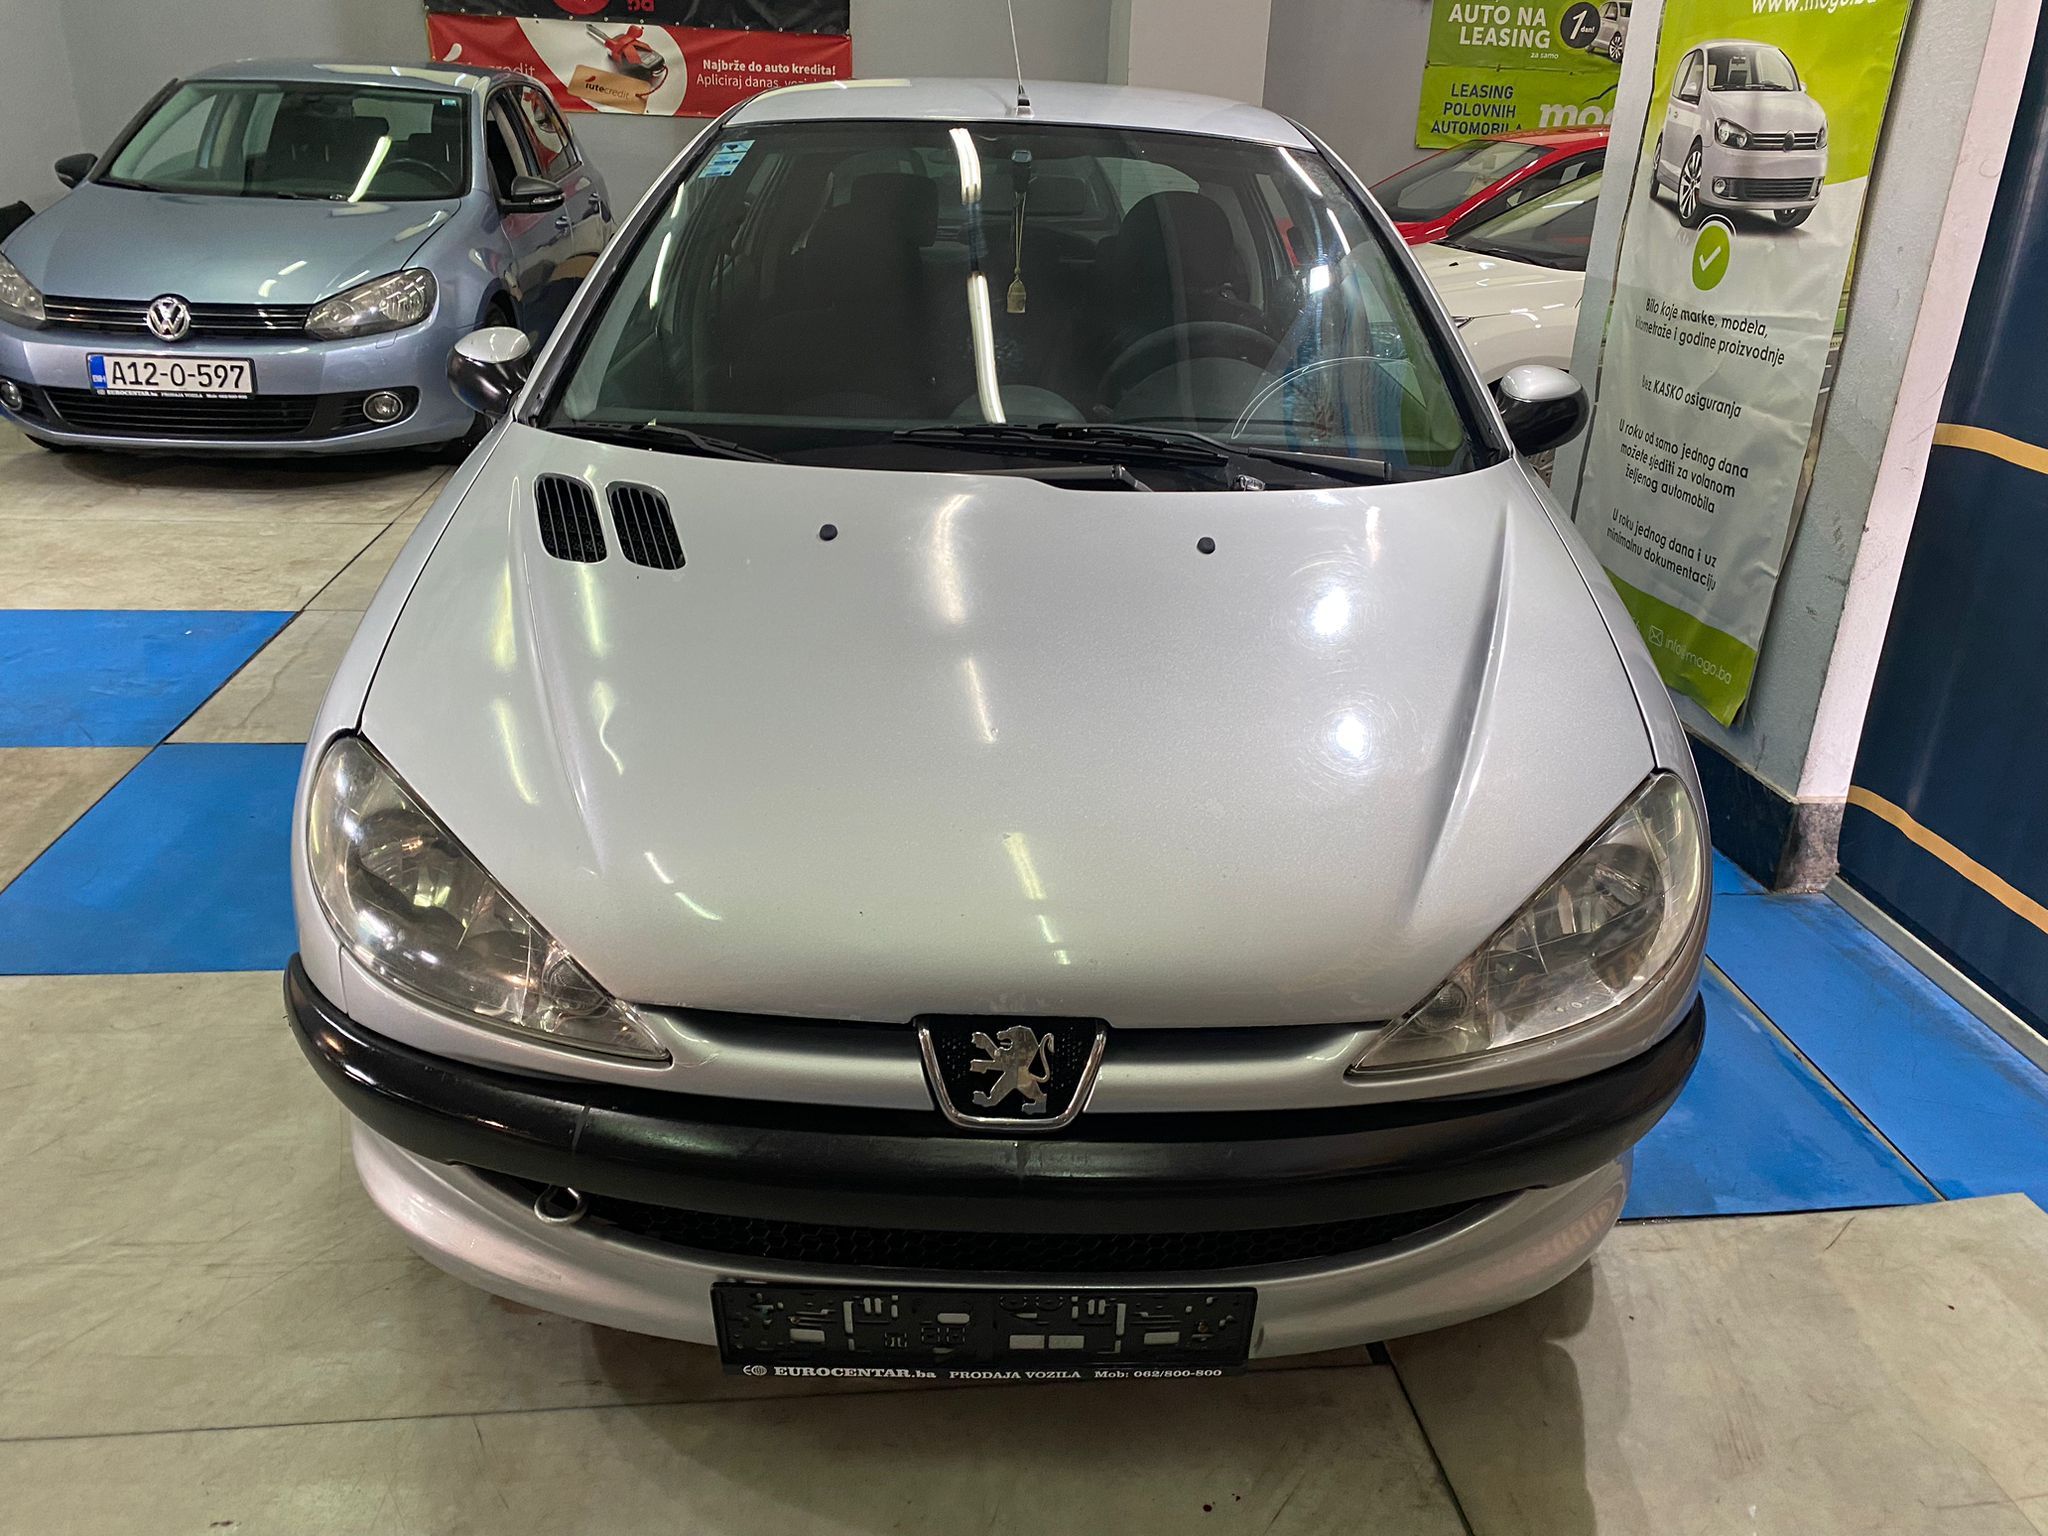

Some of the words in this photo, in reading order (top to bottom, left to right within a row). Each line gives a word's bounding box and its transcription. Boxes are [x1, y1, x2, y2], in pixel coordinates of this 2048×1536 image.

[1448, 3, 1511, 25] AUTO
[1517, 7, 1547, 27] NA
[1752, 0, 1876, 13] www.mog.
[1570, 10, 1588, 40] 1
[1459, 26, 1550, 49] LEASING
[702, 59, 746, 72] Najbrže
[748, 61, 762, 72] do
[764, 63, 790, 74] auto
[792, 63, 836, 76] kredita!
[1540, 52, 1559, 60] samo
[696, 74, 742, 90] Apliciraj
[1451, 83, 1514, 99] LEASING
[1443, 102, 1517, 118] POLOVNIH
[1538, 104, 1614, 128] mo
[1645, 297, 1659, 314] Bilo
[1660, 301, 1678, 321] koje
[1680, 309, 1718, 329] marke,
[1721, 316, 1768, 339] modela,
[1673, 326, 1678, 341] i
[1678, 331, 1717, 350] godine
[1717, 340, 1785, 367] proizvodnje
[1652, 379, 1684, 401] KASKO
[1684, 391, 1742, 419] osiguranja
[1618, 418, 1625, 432] U
[1624, 423, 1644, 440] roku
[1644, 431, 1655, 445] od
[1655, 436, 1679, 455] samo
[1680, 442, 1716, 471] jednog
[1718, 458, 1749, 479] dana
[1620, 442, 1648, 464] možete
[1648, 454, 1676, 475] sjediti
[1676, 466, 1688, 480] za
[1691, 471, 1736, 498] volanom
[1625, 463, 1659, 493] željenog
[1661, 482, 1715, 514] automobila
[1612, 507, 1619, 521] U
[1618, 514, 1634, 531] roku
[1634, 520, 1667, 550] jednog
[1668, 537, 1695, 559] dana
[1697, 548, 1702, 562] i
[1704, 554, 1718, 568] uz
[1606, 527, 1643, 556] minimalnu
[1643, 547, 1717, 592] dokumentaciju
[773, 1366, 937, 1379] EUROCENTAR.ba
[949, 1370, 1022, 1379] PRODAJA
[1024, 1370, 1082, 1379] VOZILA
[1094, 1370, 1129, 1379] Mob:
[1133, 1369, 1222, 1379] 062/800-800
